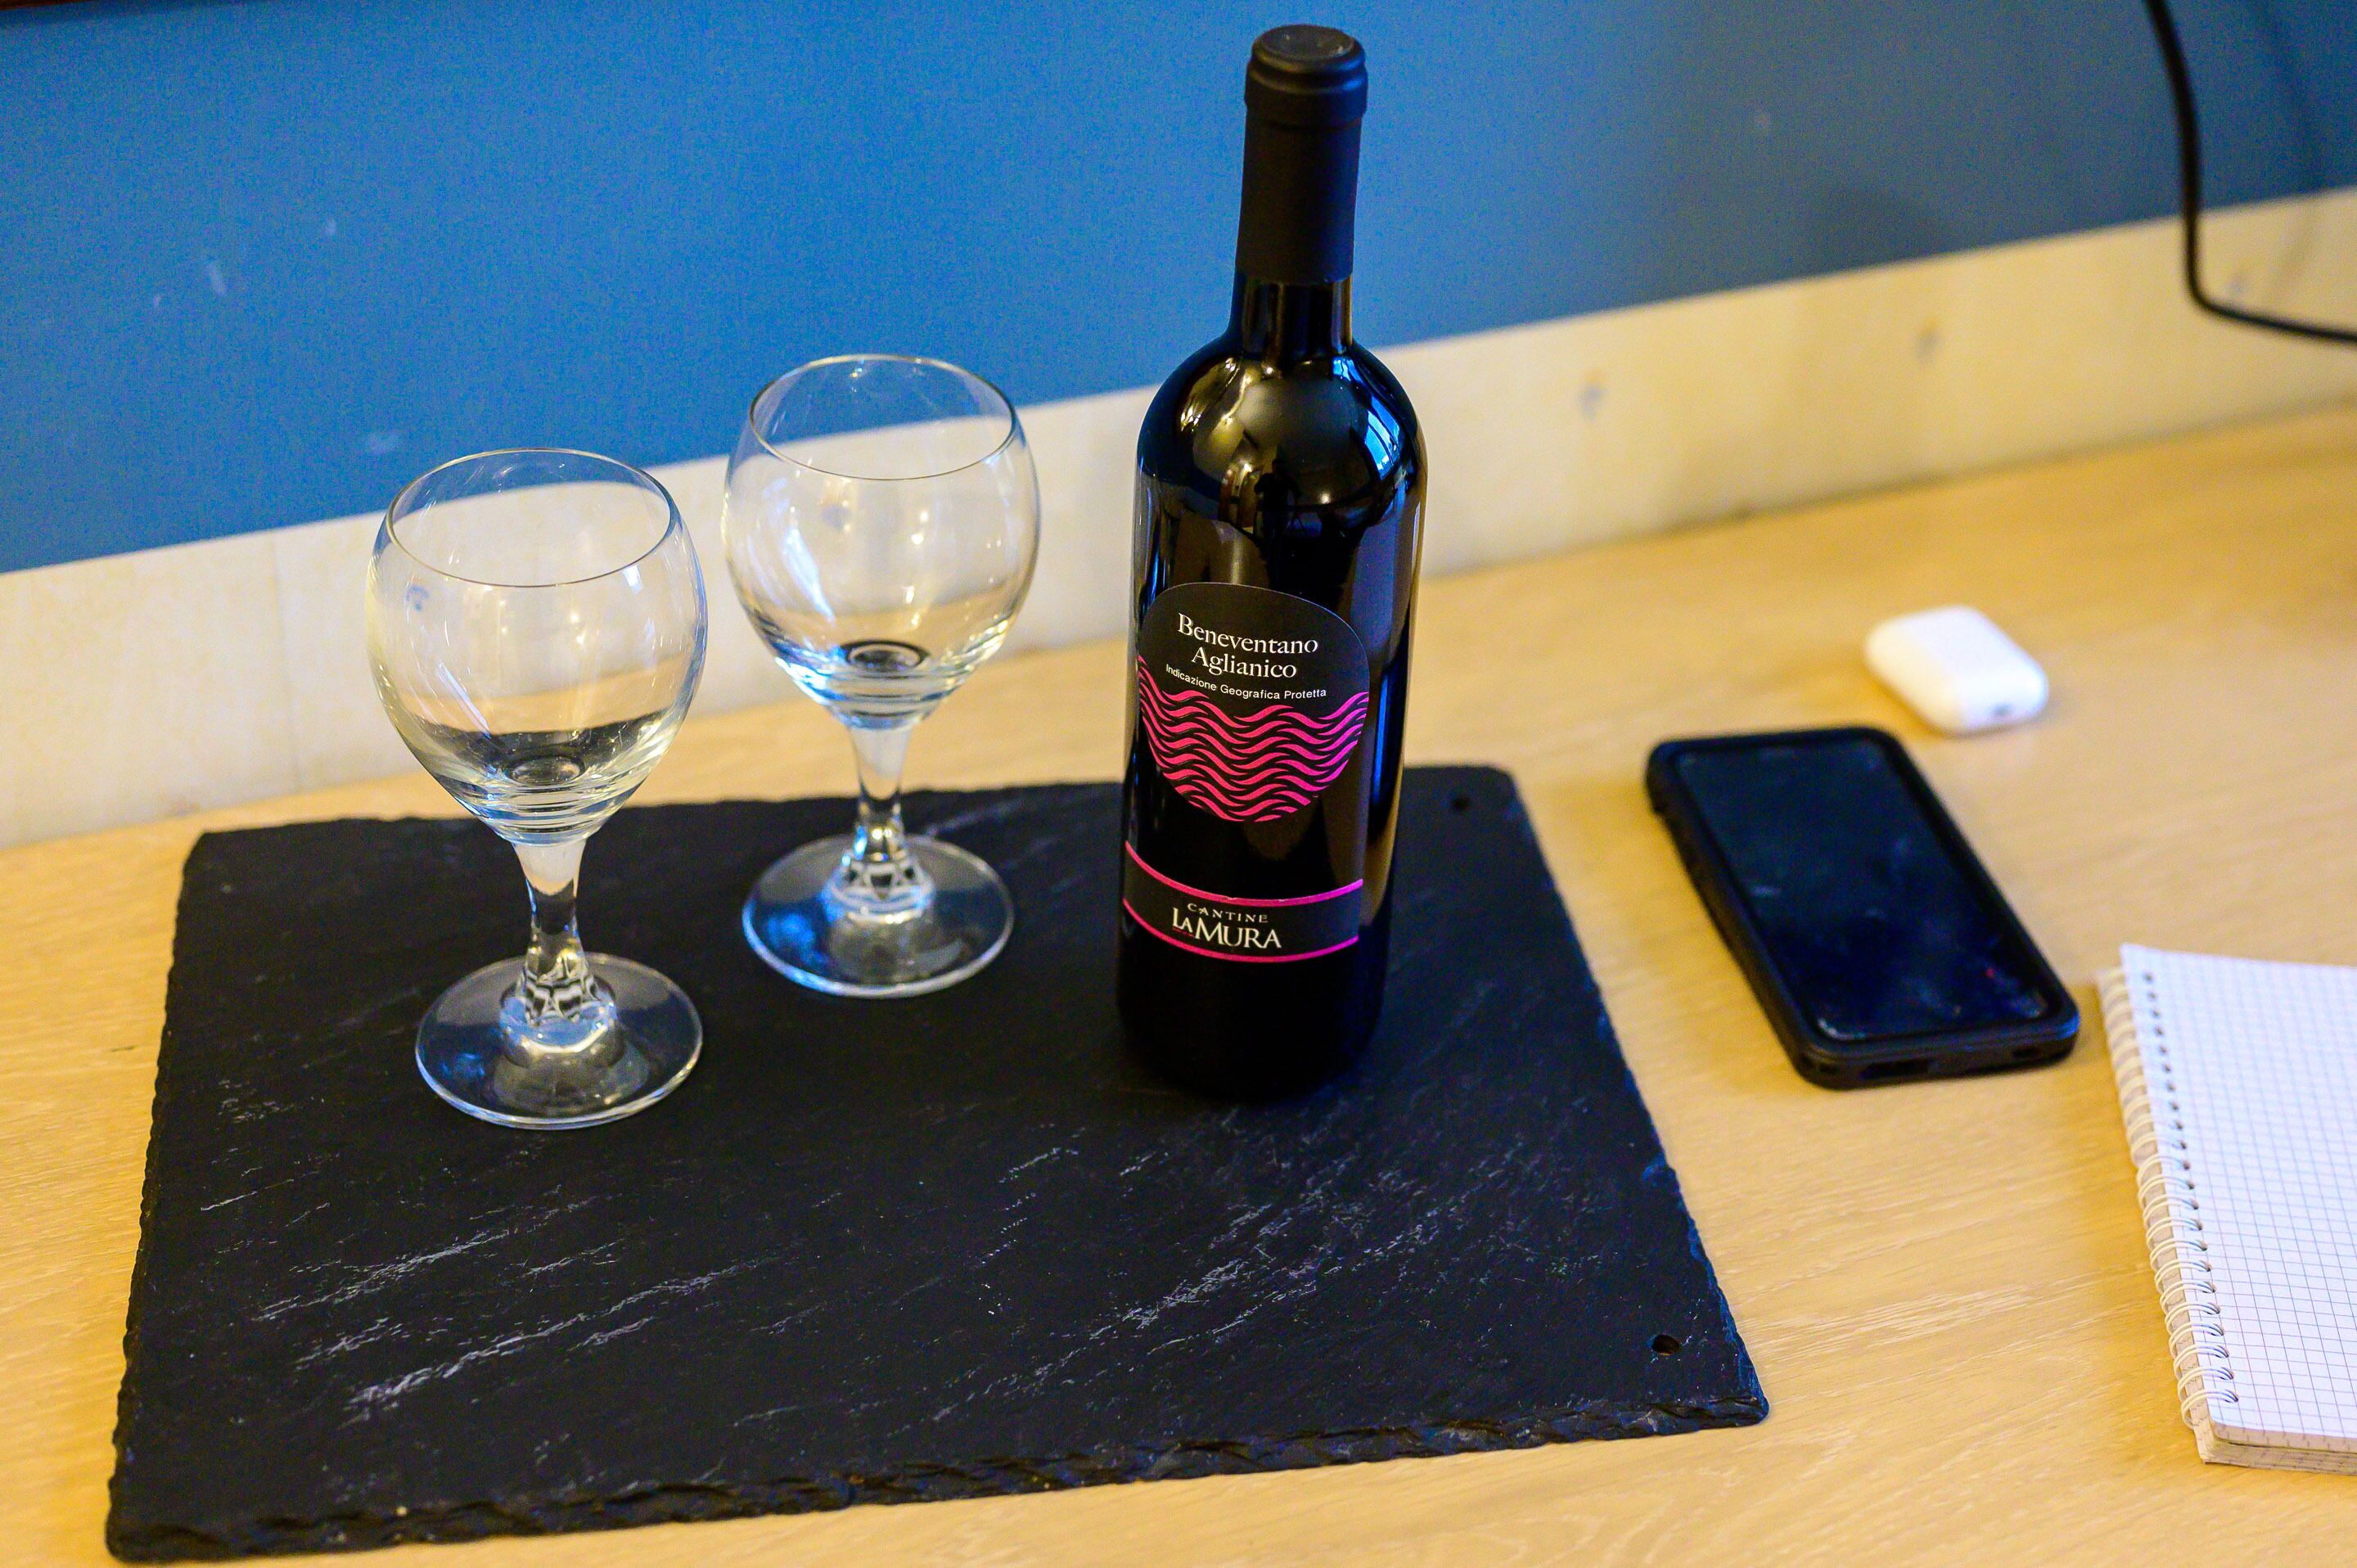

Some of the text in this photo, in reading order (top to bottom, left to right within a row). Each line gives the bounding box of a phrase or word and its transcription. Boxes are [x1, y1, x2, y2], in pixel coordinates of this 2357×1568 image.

[1178, 613, 1318, 654] Beneventano
[1191, 647, 1297, 678] Aglianico
[1165, 663, 1327, 700] Indicazione Geografica Protetta
[1187, 902, 1269, 924] CANTINE
